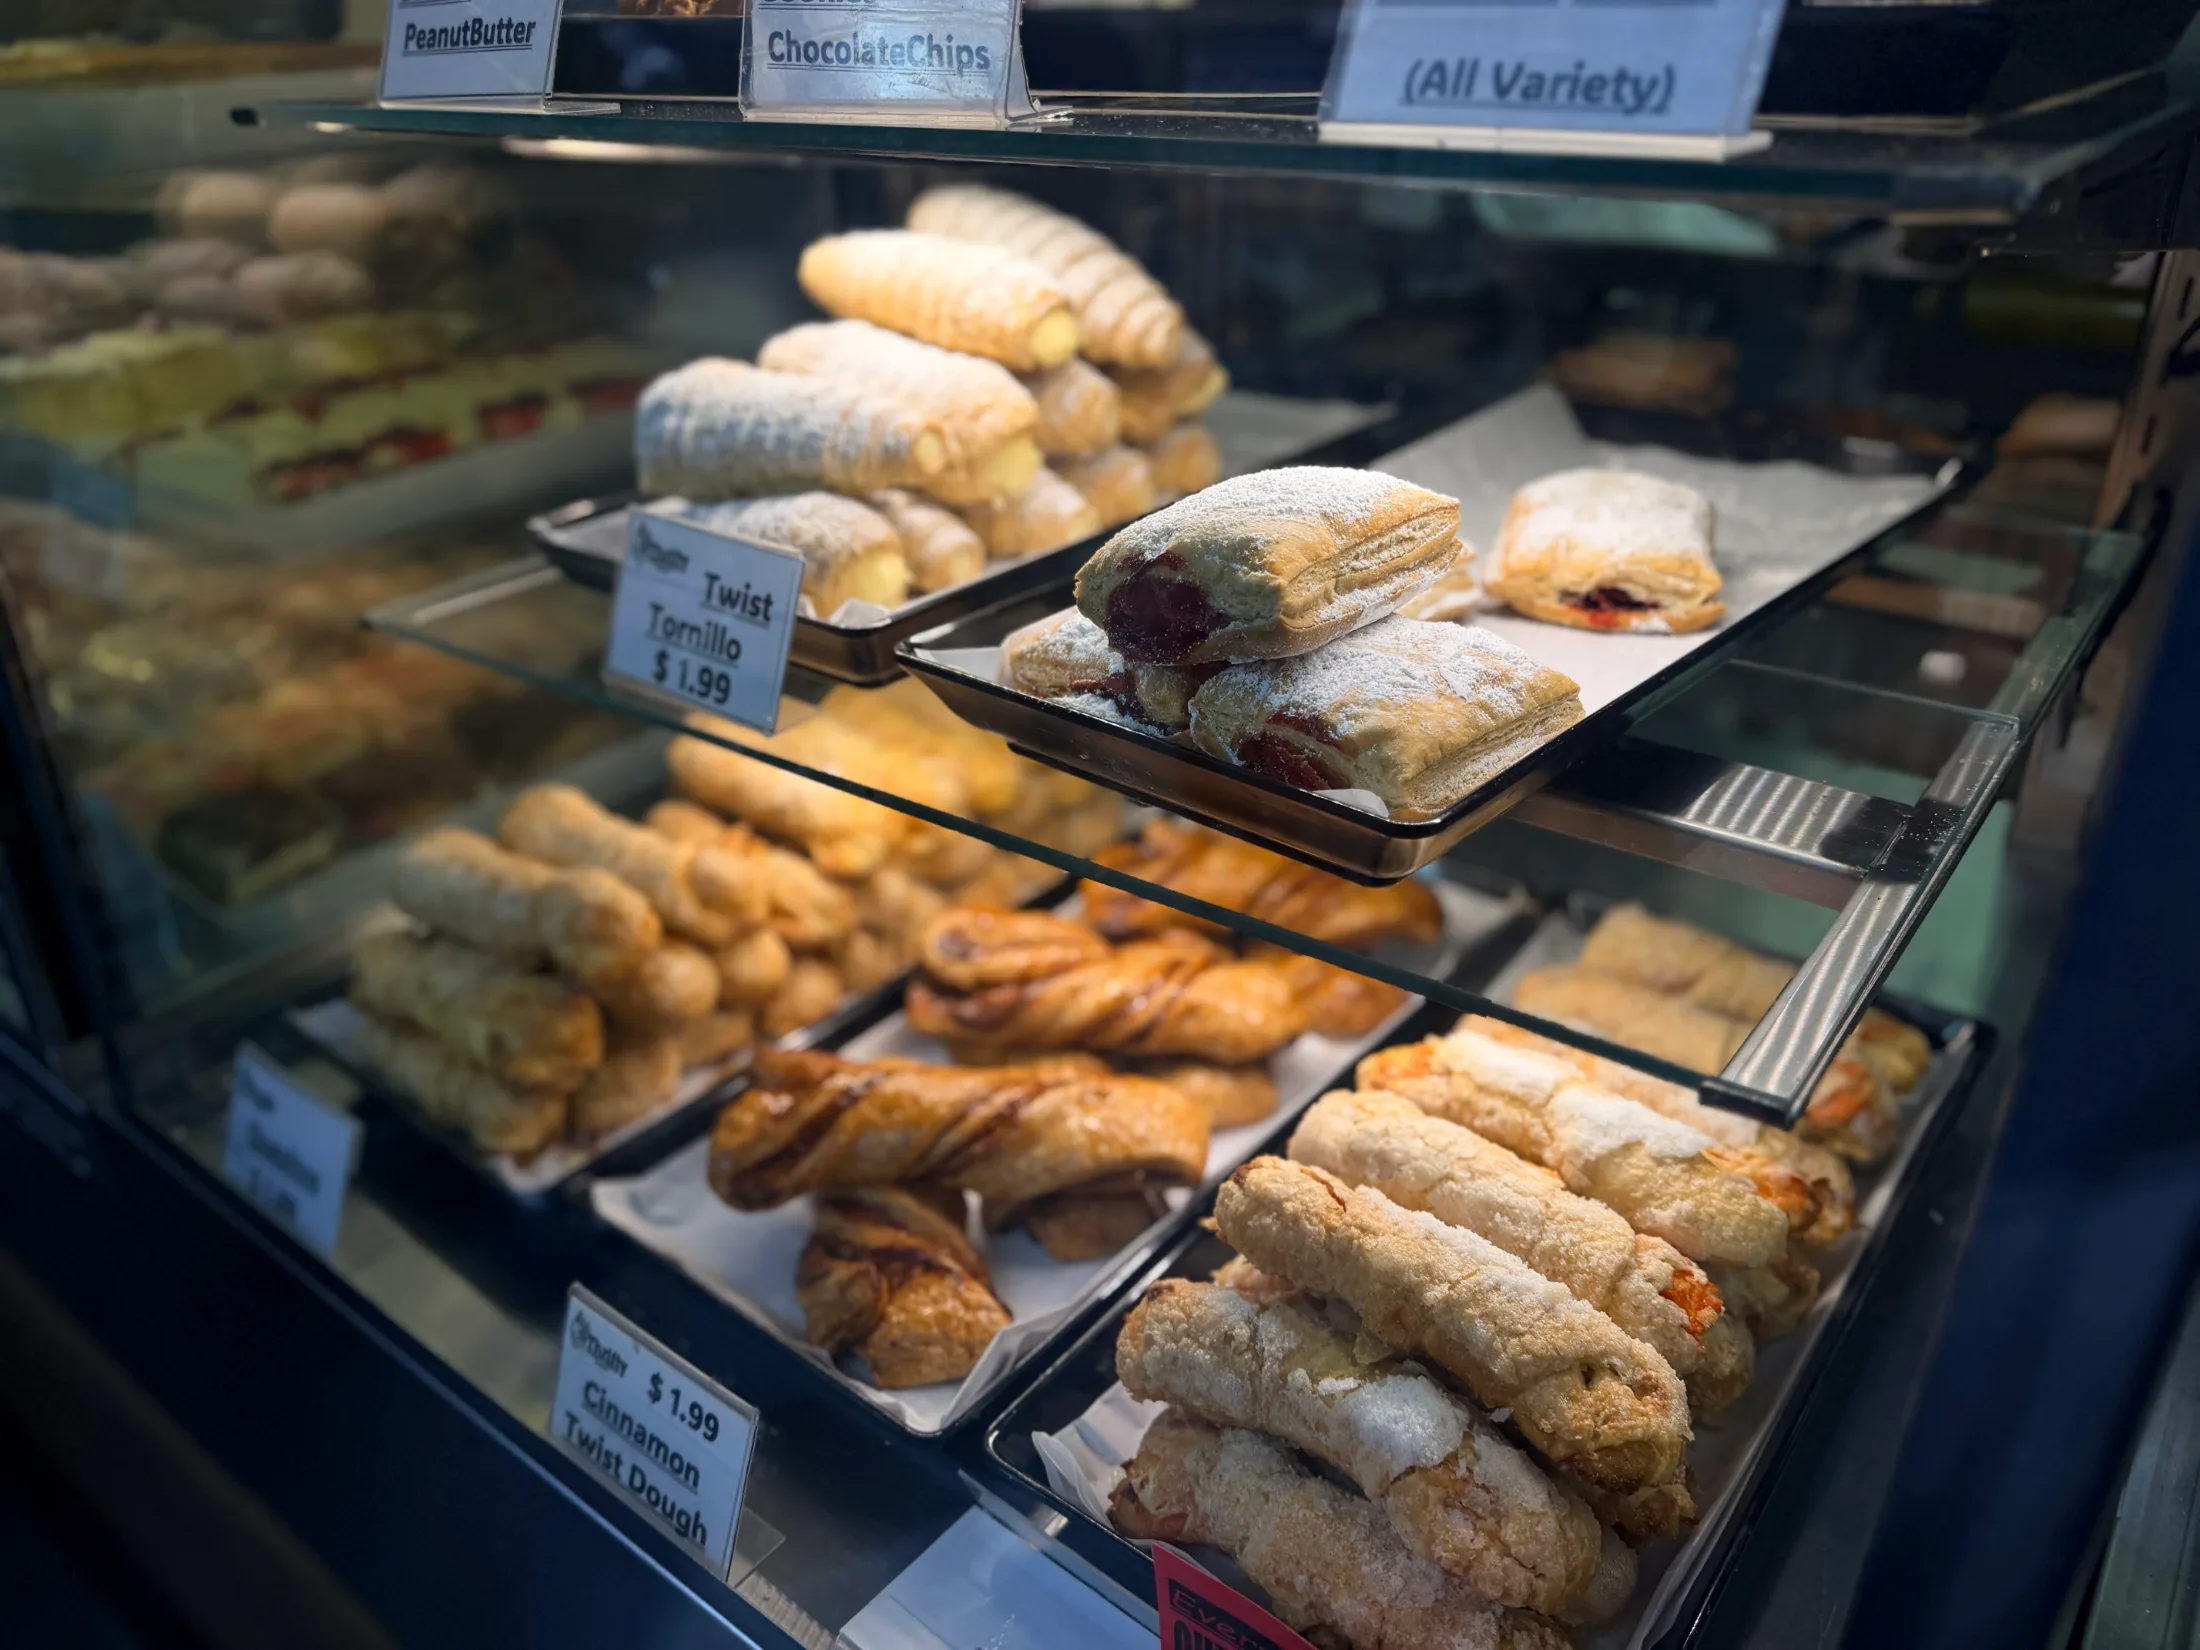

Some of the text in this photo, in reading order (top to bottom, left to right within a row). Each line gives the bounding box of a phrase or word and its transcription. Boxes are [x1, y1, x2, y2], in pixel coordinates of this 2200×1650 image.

[404, 17, 537, 50] PeanutButter
[767, 29, 991, 76] ChocolateChips
[1403, 57, 1676, 117] (All Variety)
[705, 572, 774, 623] Twist
[649, 603, 742, 661] Tornillo
[584, 1380, 700, 1489] Cinnamon
[565, 1410, 708, 1547] Twist Dough
